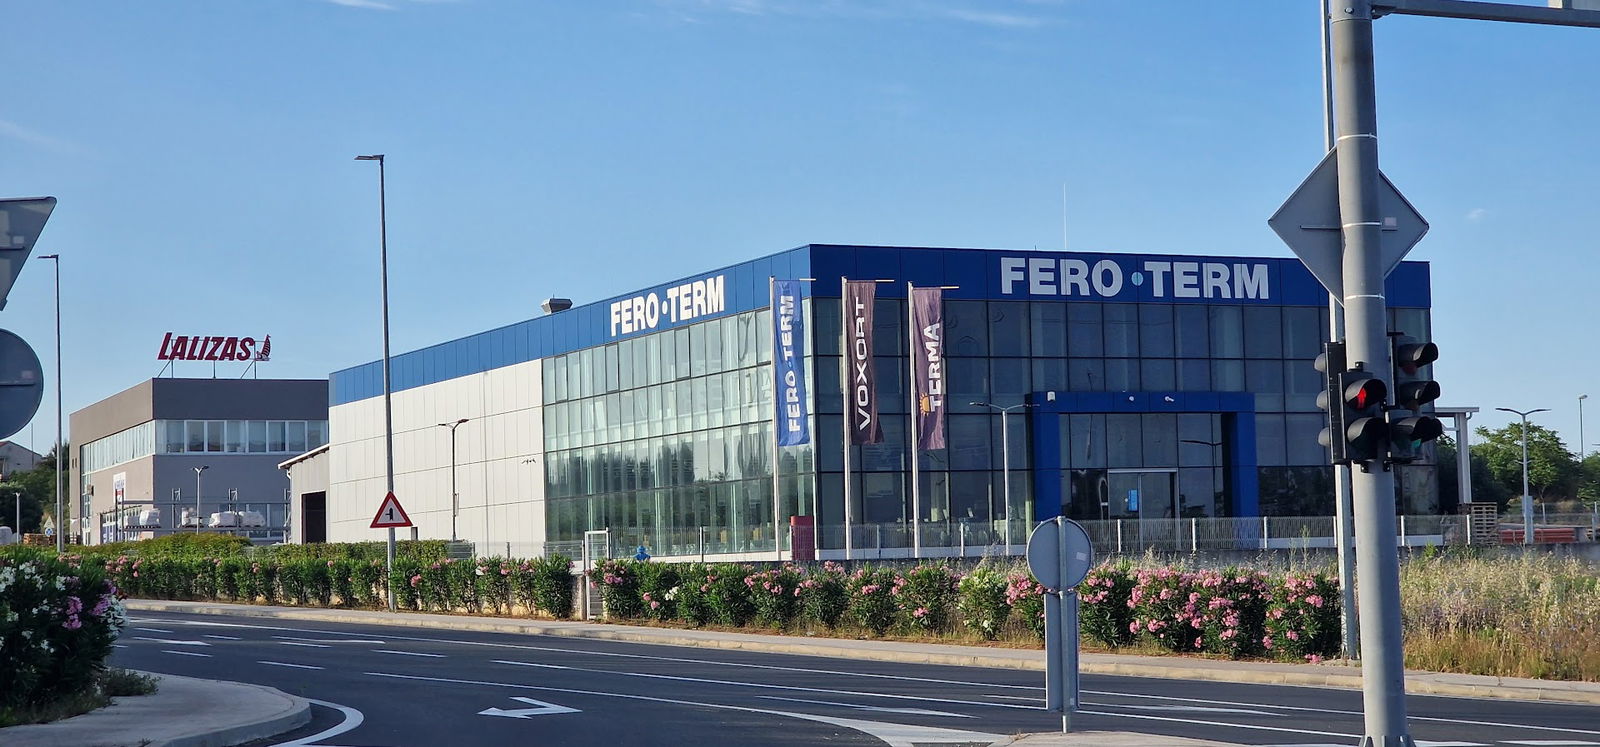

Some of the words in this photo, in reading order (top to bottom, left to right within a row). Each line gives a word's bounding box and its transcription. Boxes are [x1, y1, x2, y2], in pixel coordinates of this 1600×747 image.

[157, 332, 256, 361] LALIZAS
[855, 296, 871, 431] VOXORT
[923, 322, 942, 413] TERMA
